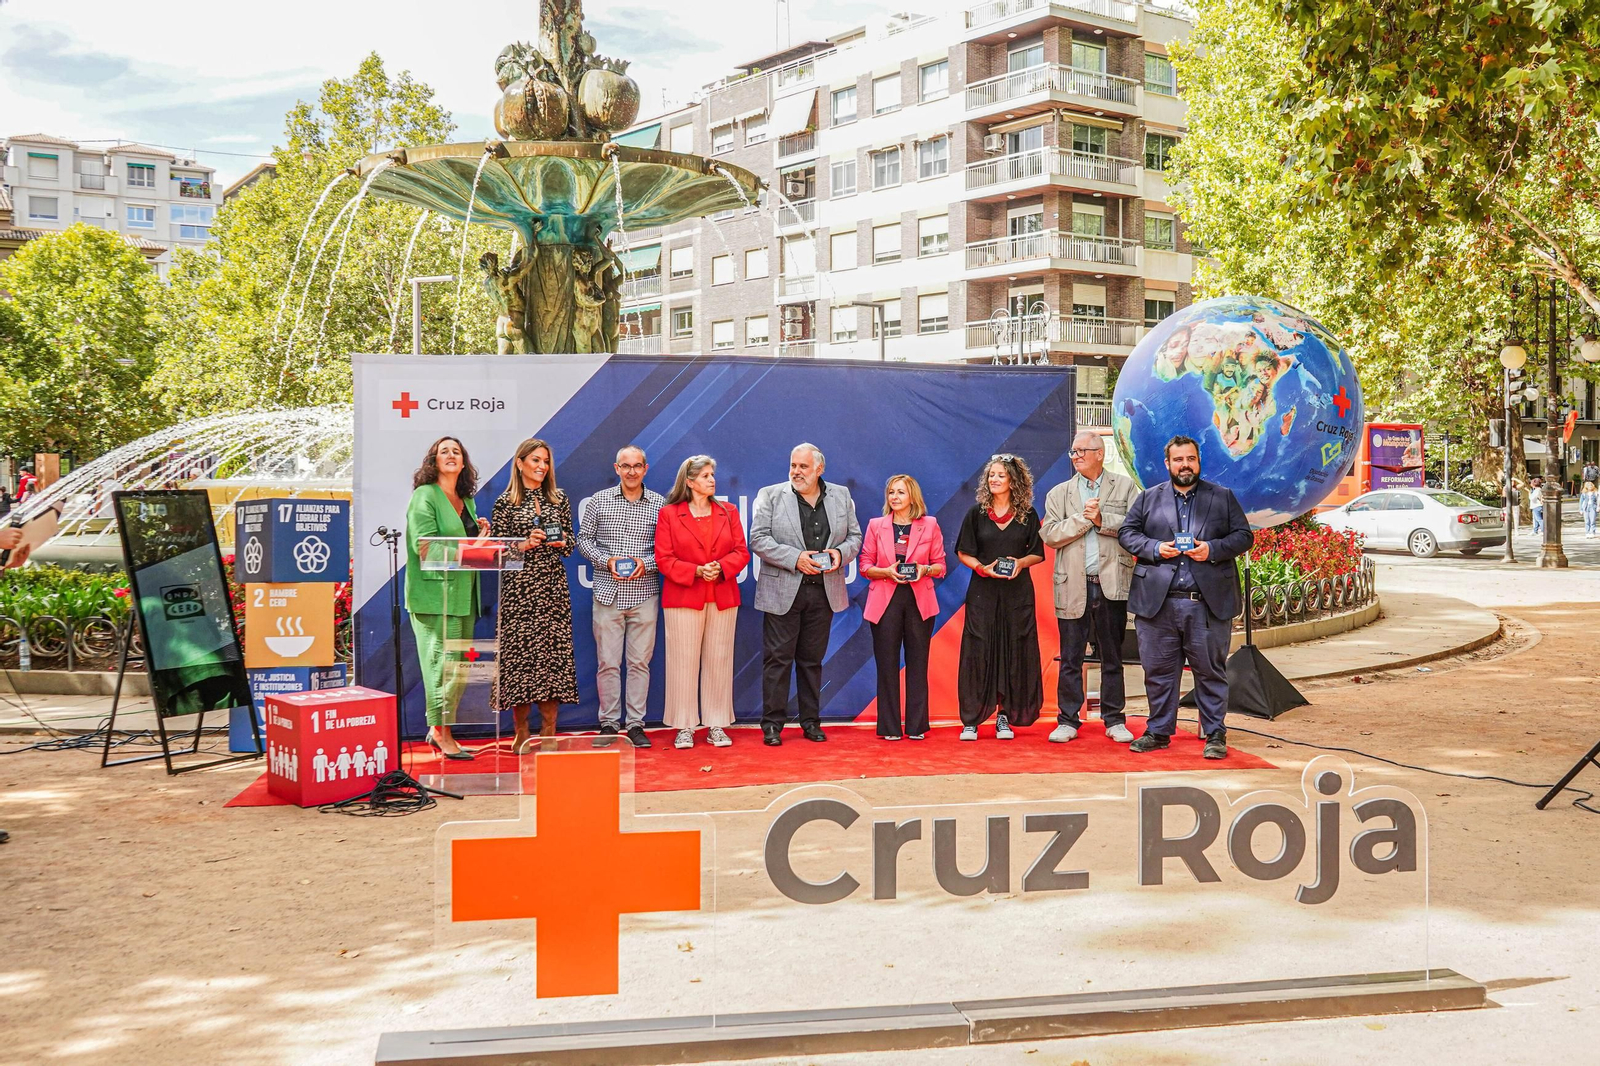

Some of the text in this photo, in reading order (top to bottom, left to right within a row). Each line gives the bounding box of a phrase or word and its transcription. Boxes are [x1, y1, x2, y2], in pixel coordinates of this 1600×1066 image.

[427, 397, 505, 413] Cruz Roja
[1316, 421, 1338, 435] Cruz
[278, 504, 293, 522] 17
[296, 504, 340, 514] ALIANZAS PARA
[237, 506, 245, 525] 17
[296, 513, 331, 523] LOGRAR LOS
[296, 522, 328, 532] OBJETIVOS
[618, 562, 632, 571] GRACIAS
[166, 591, 198, 600] ONDA
[253, 588, 264, 607] 2
[269, 589, 298, 598] HAMBRE
[269, 598, 287, 607] CERO
[171, 604, 199, 613] CERO
[253, 673, 296, 683] PAZ, JUSTICIA
[310, 672, 320, 691] 16
[253, 682, 303, 691] E INSTITUCIONES
[267, 703, 272, 725] 1
[325, 709, 337, 720] FIN
[311, 711, 320, 733] 1
[325, 714, 377, 730] DE LA POBREZA
[764, 769, 1417, 904] Cruz Roja
